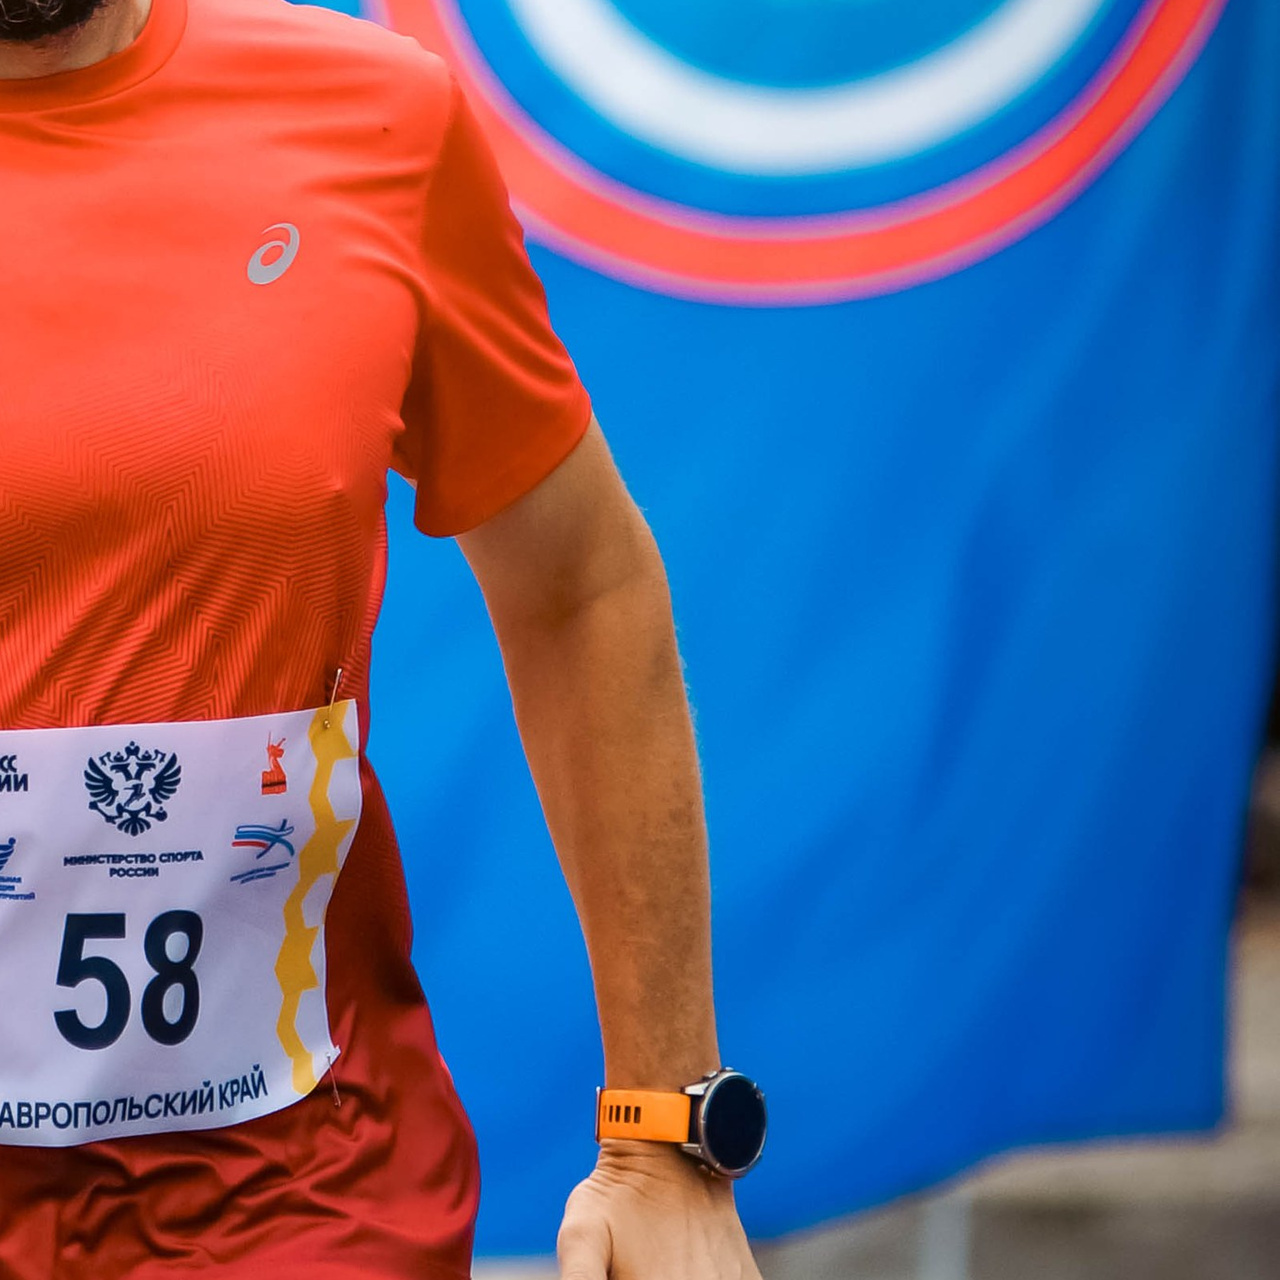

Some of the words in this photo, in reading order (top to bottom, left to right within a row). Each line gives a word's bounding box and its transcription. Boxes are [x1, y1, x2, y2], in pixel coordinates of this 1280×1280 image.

[63, 853, 157, 867] МИНИСТЕРСТВО
[158, 850, 204, 863] СПОРТА
[109, 867, 159, 878] РОССИИ
[53, 909, 204, 1051] 58
[219, 1063, 268, 1110] КРАЙ
